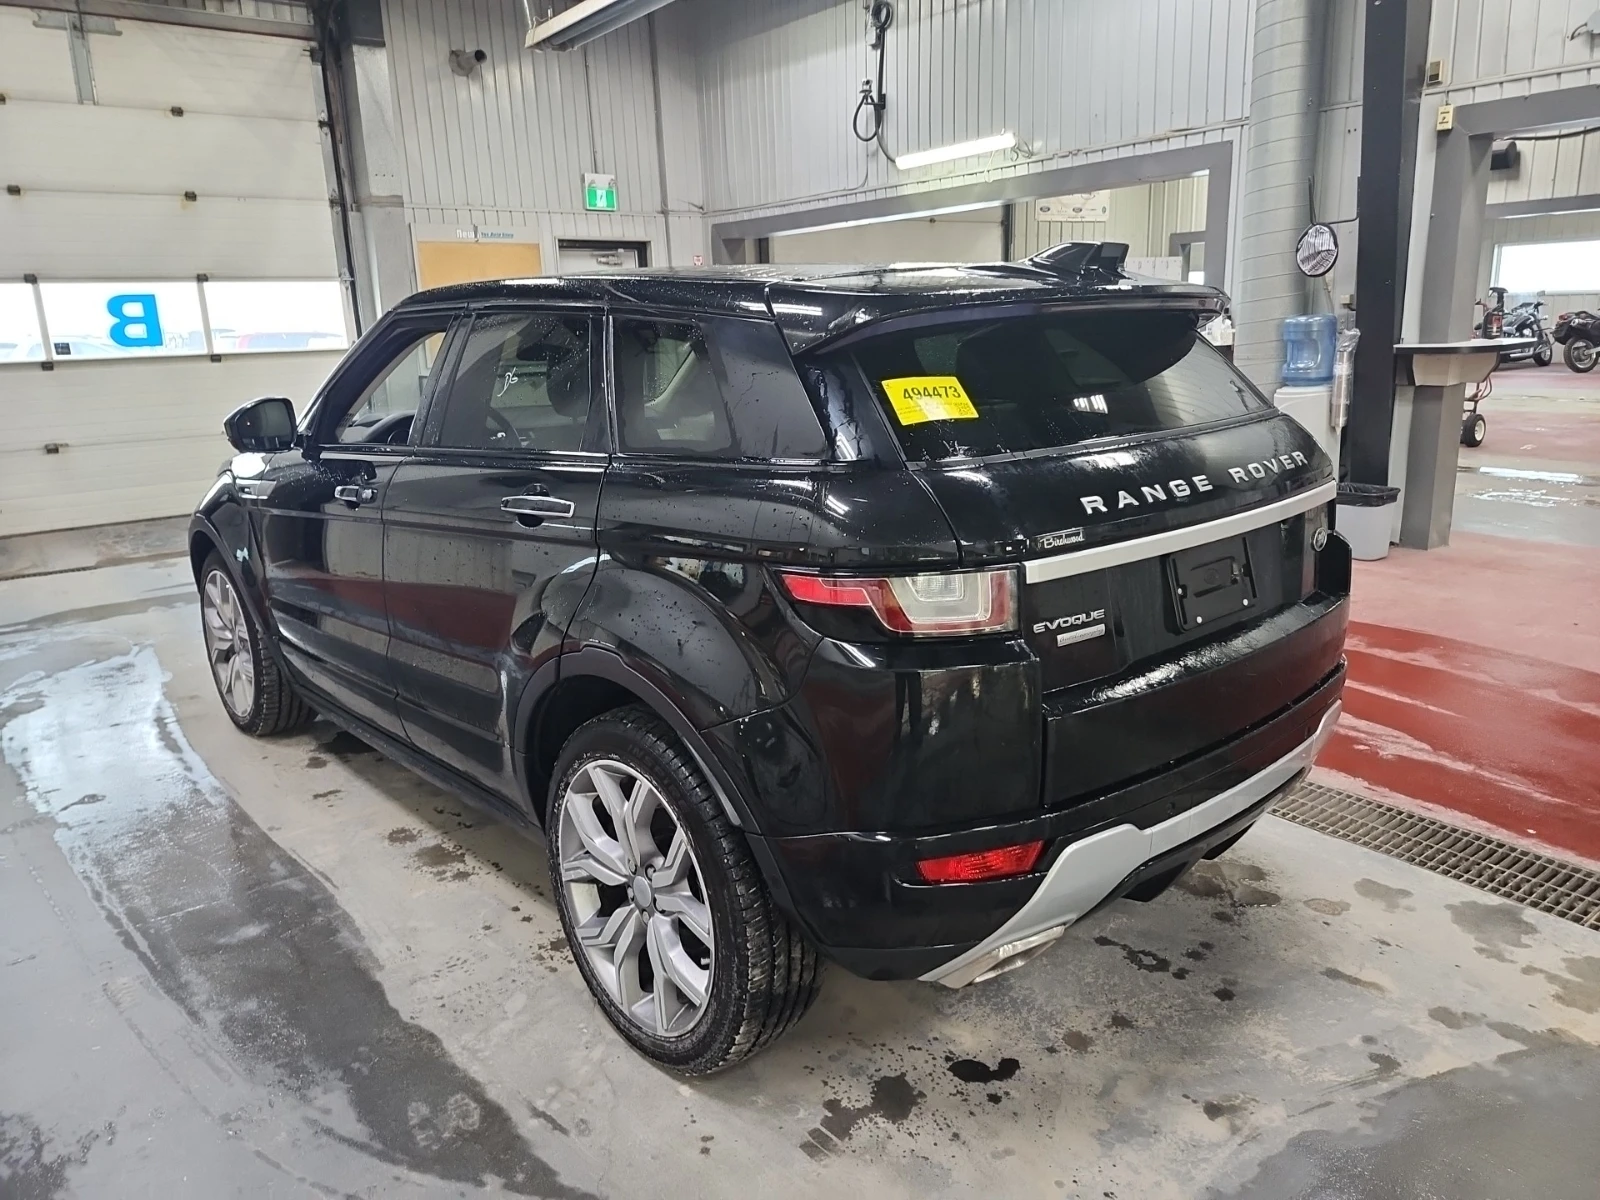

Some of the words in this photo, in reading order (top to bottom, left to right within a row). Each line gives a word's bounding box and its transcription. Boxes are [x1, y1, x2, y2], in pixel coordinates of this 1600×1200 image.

[903, 386, 961, 400] 494473
[1080, 475, 1213, 514] RANGE
[1228, 451, 1308, 484] ROVER
[1033, 609, 1105, 633] EVOQUE
